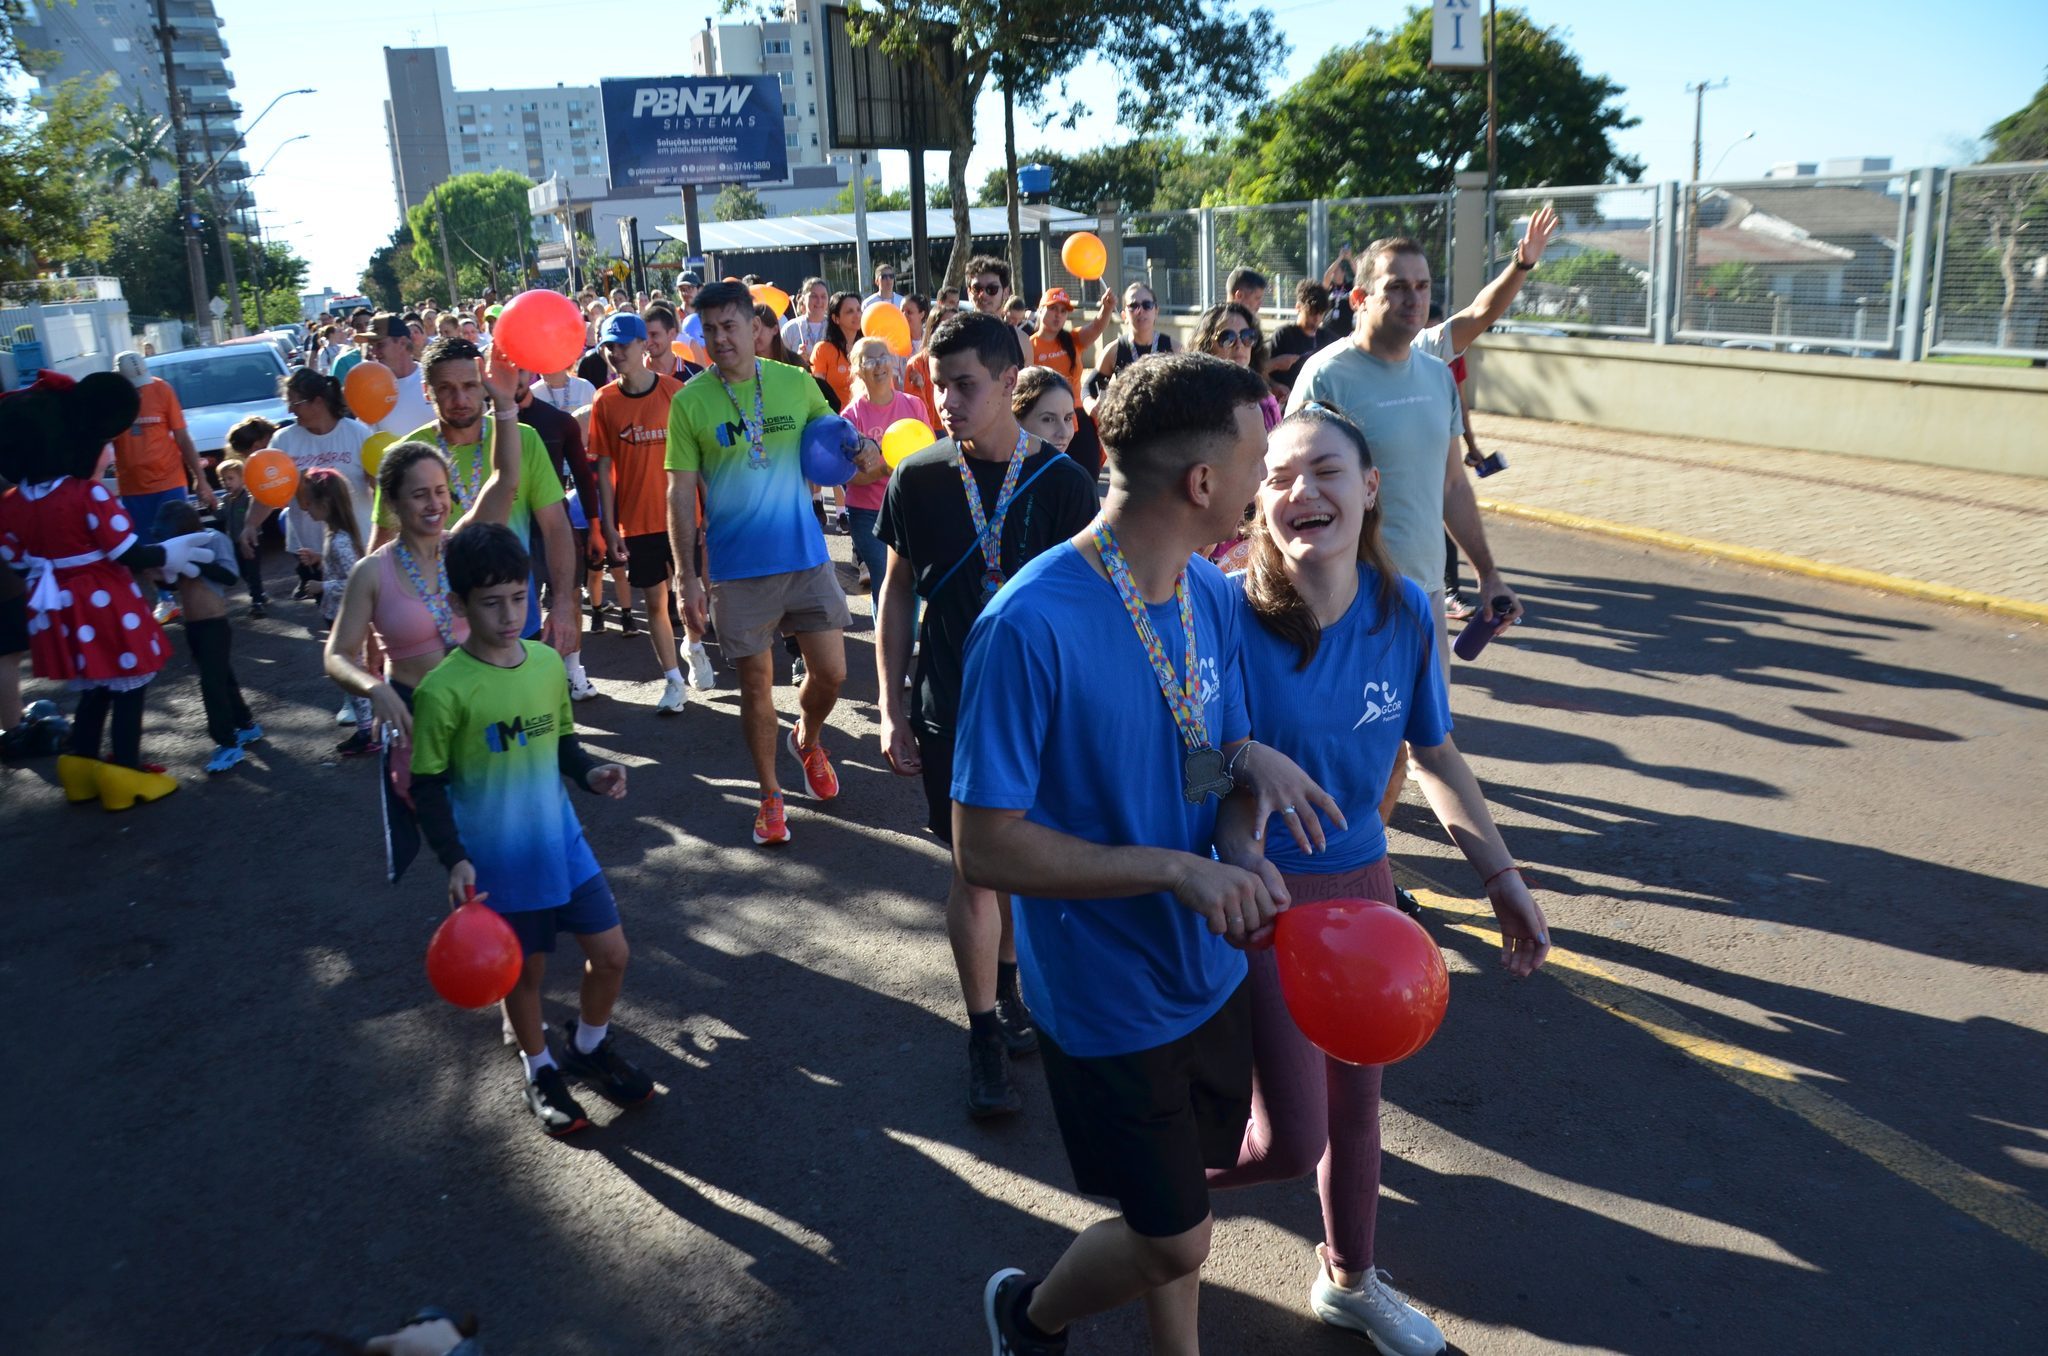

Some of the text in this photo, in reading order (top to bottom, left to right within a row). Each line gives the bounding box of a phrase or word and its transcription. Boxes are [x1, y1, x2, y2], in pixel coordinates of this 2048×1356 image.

[633, 85, 753, 118] PBNEW
[664, 116, 755, 130] SISTEMAS
[657, 136, 737, 148] Soluções tecnológicas
[670, 146, 702, 156] produtos
[635, 166, 678, 177] pbnew.com.br
[608, 321, 621, 332] A
[1381, 700, 1402, 715] GCOR
